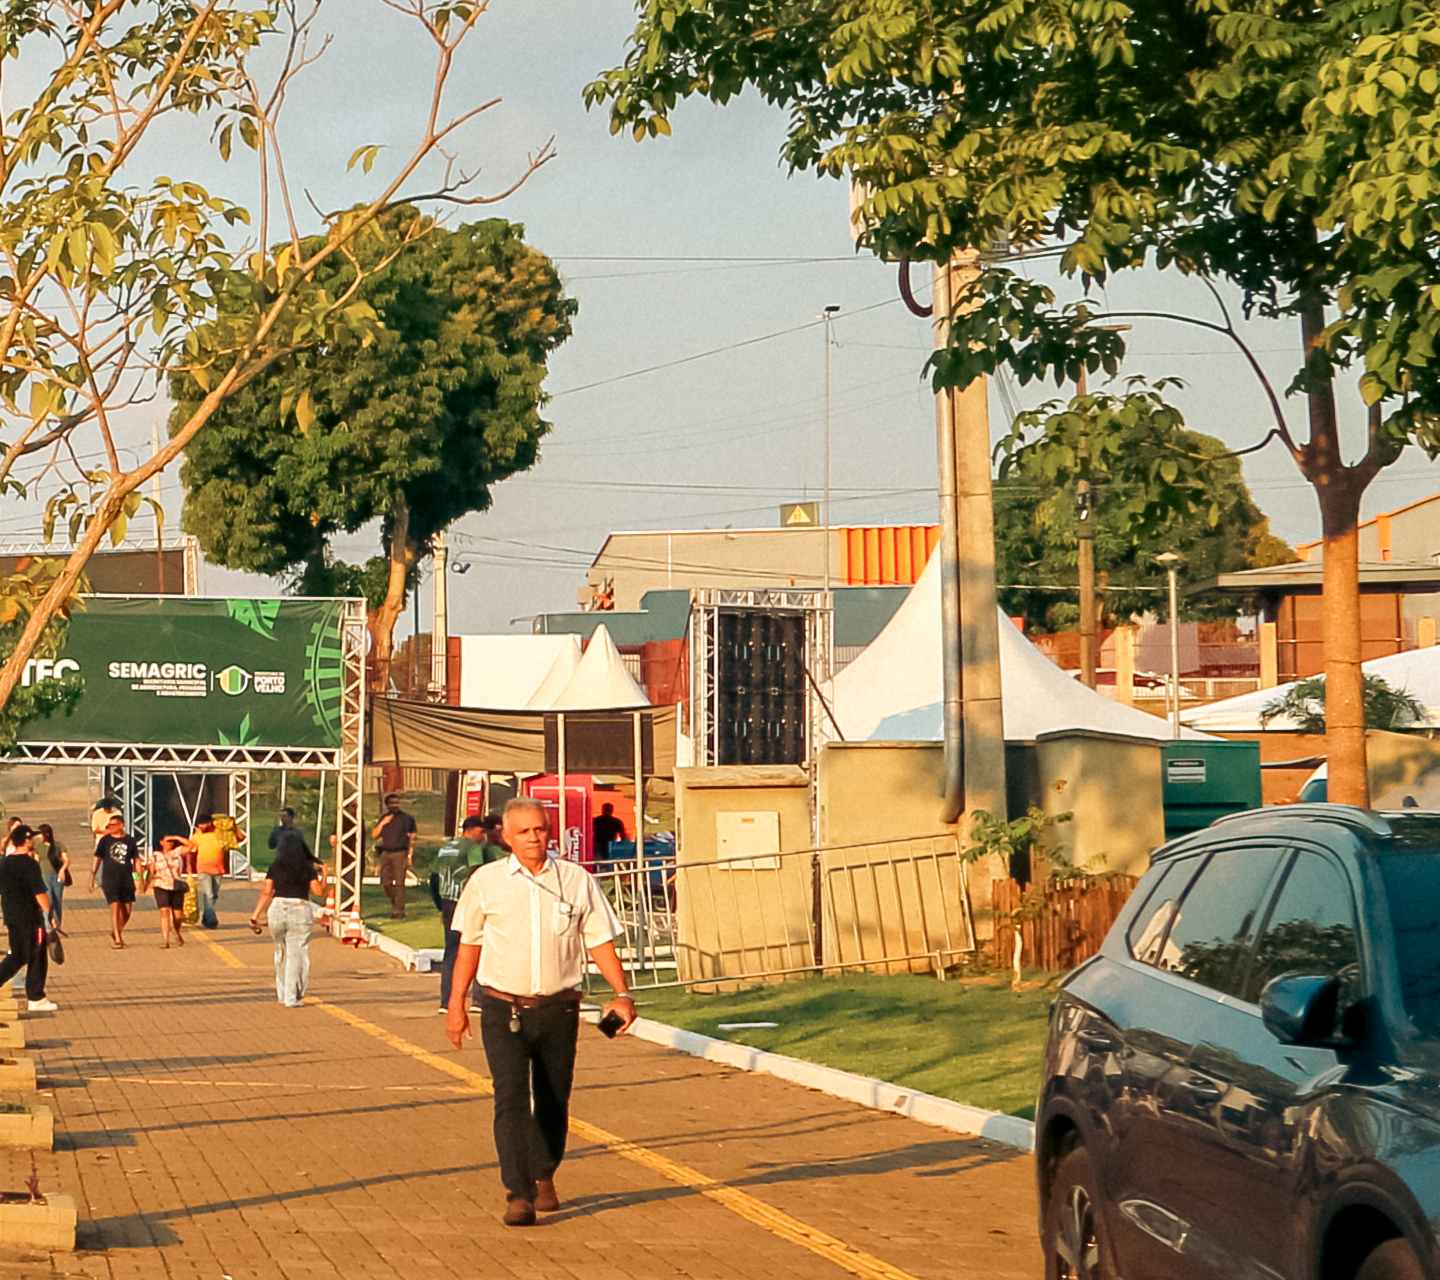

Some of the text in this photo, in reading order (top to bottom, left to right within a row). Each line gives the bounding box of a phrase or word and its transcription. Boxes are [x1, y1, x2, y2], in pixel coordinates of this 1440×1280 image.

[108, 661, 207, 679] SEMAGRIC
[254, 676, 284, 685] PORTO
[254, 684, 285, 693] VELHO
